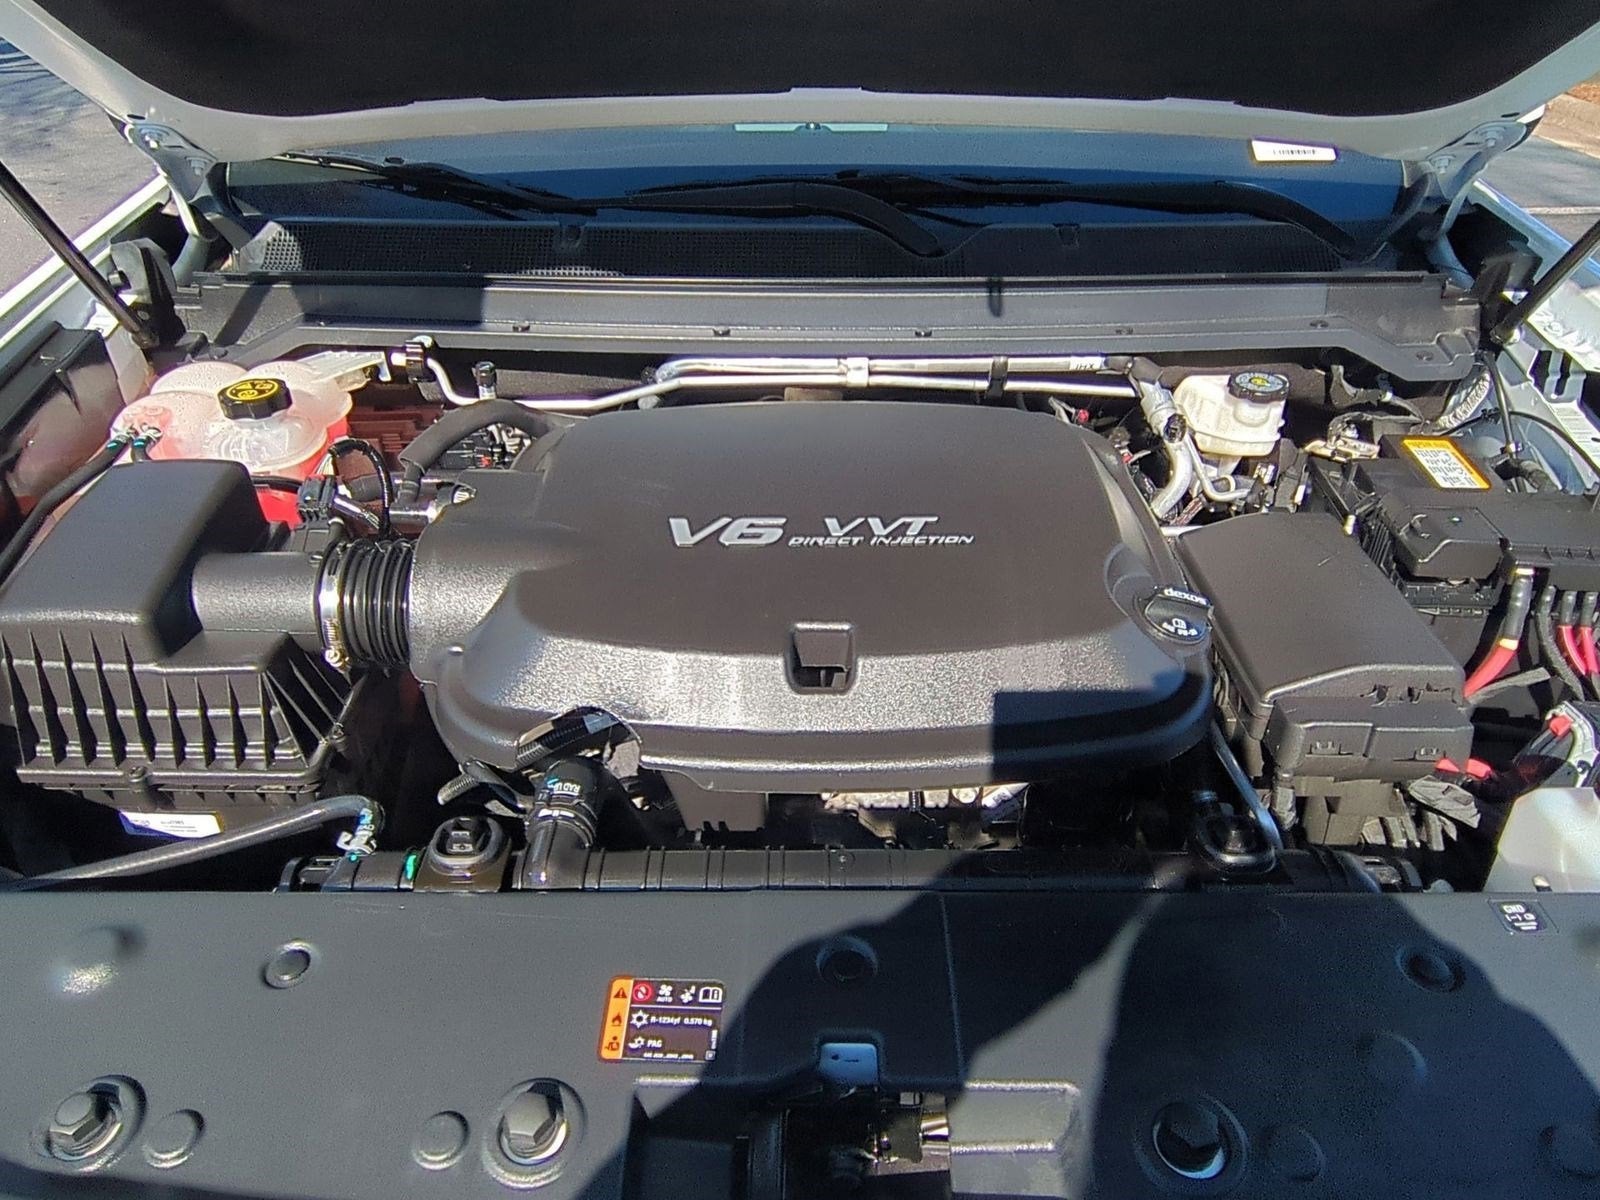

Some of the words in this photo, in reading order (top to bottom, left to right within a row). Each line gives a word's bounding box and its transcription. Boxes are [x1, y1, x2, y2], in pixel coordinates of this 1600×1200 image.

[668, 517, 788, 547] V6
[824, 516, 939, 536] VVT
[788, 536, 864, 547] DIRECT
[869, 535, 975, 547] INJECTION
[1164, 587, 1207, 606] dexos
[647, 1039, 662, 1048] PAG
